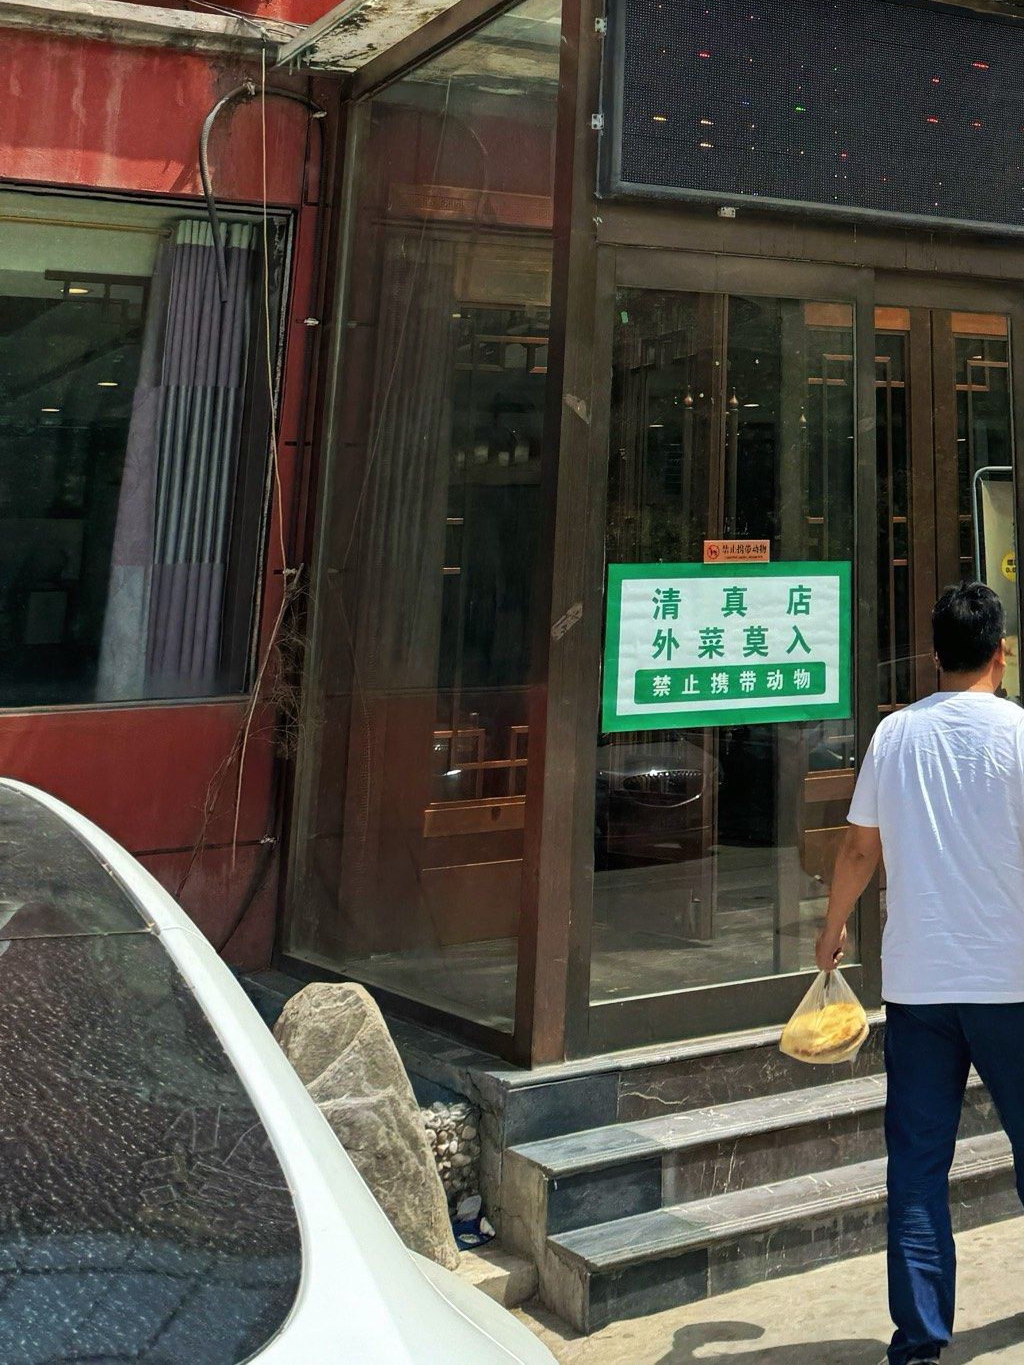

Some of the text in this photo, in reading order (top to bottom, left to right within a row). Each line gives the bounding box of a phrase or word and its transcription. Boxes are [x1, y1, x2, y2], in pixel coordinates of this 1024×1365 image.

[722, 544, 767, 554] 禁止携带动物
[652, 585, 812, 620] 清真店
[652, 625, 812, 660] 外菜莫入
[652, 669, 811, 697] 禁止携带动物
